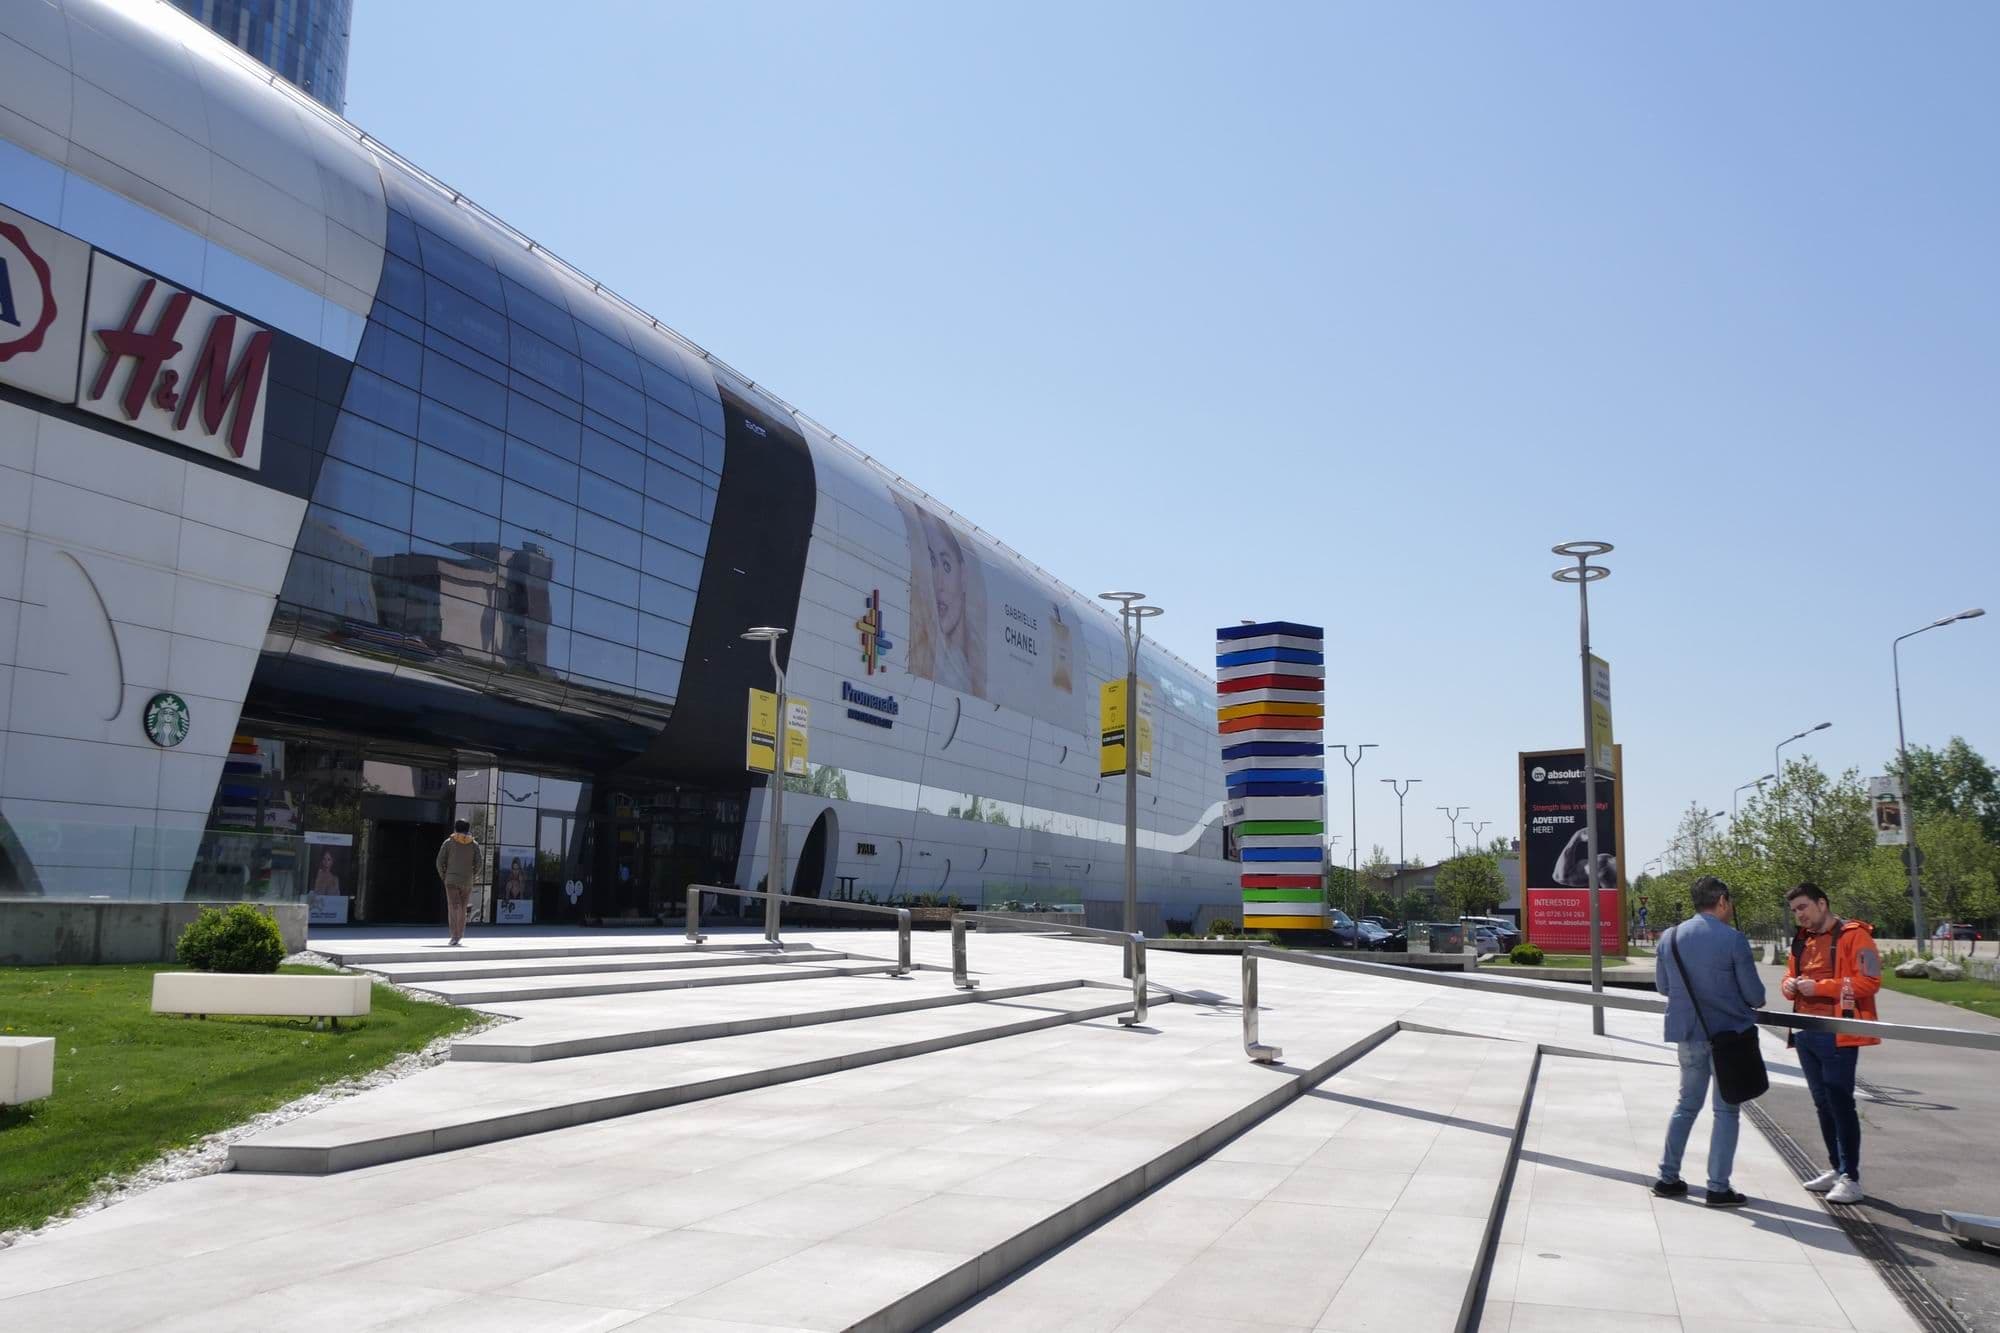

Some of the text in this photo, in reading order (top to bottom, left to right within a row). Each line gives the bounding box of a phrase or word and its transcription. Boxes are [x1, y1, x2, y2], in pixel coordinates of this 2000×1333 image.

[88, 279, 272, 458] H&M
[1004, 603, 1038, 631] GABRIELLE
[1005, 626, 1038, 656] CHANEL
[842, 681, 899, 716] Promenada
[1532, 816, 1575, 824] ADVERTISE
[1532, 825, 1554, 834] HERE!
[1534, 899, 1580, 907] INTERESTED?
